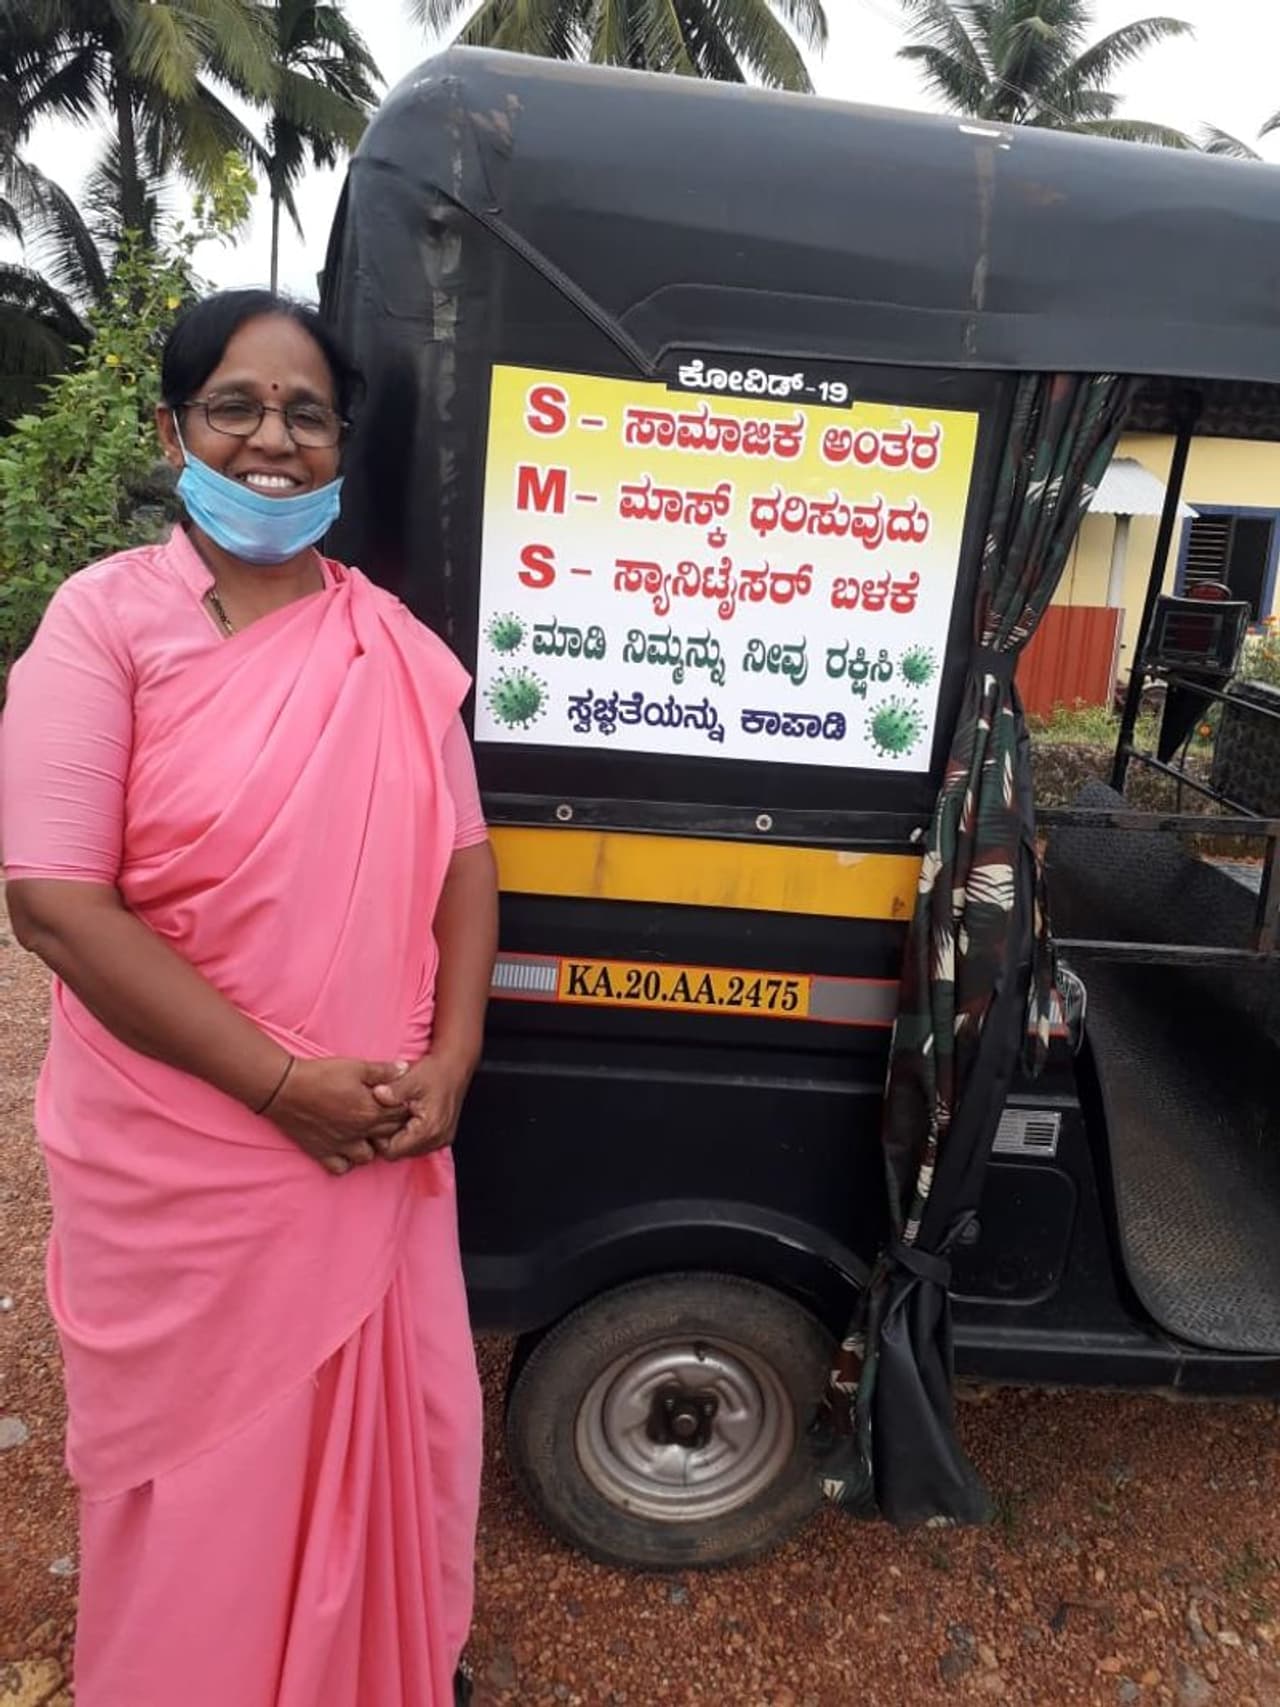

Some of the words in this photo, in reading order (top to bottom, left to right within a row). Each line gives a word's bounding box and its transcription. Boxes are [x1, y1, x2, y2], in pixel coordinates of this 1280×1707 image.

[678, 361, 849, 402] ಕೋವಿಡ್-19
[526, 387, 566, 433] S
[624, 403, 804, 459] ಸಾಮಾಜಿಕ
[822, 421, 941, 470] ಅಂತರ
[517, 467, 566, 513] M
[619, 476, 731, 548] ಮಾಸ್ಕ್
[750, 488, 930, 549] ಧರಿಸುವುದು
[518, 544, 557, 588] S
[614, 556, 813, 620] ಸ್ಯಾನಿಟೈಸರ್
[831, 571, 920, 614] ಬಳಕೆ
[532, 616, 606, 660] ಮಾಡಿ
[623, 628, 726, 686] ನಿಮ್ಮನ್ನು
[743, 634, 808, 688] ನೀವು
[826, 643, 893, 698] ರಕ್ಷಿಸಿ
[741, 706, 847, 741] ಕಾಪಾಡಿ
[567, 964, 799, 1012] KA.20.AA.2475
